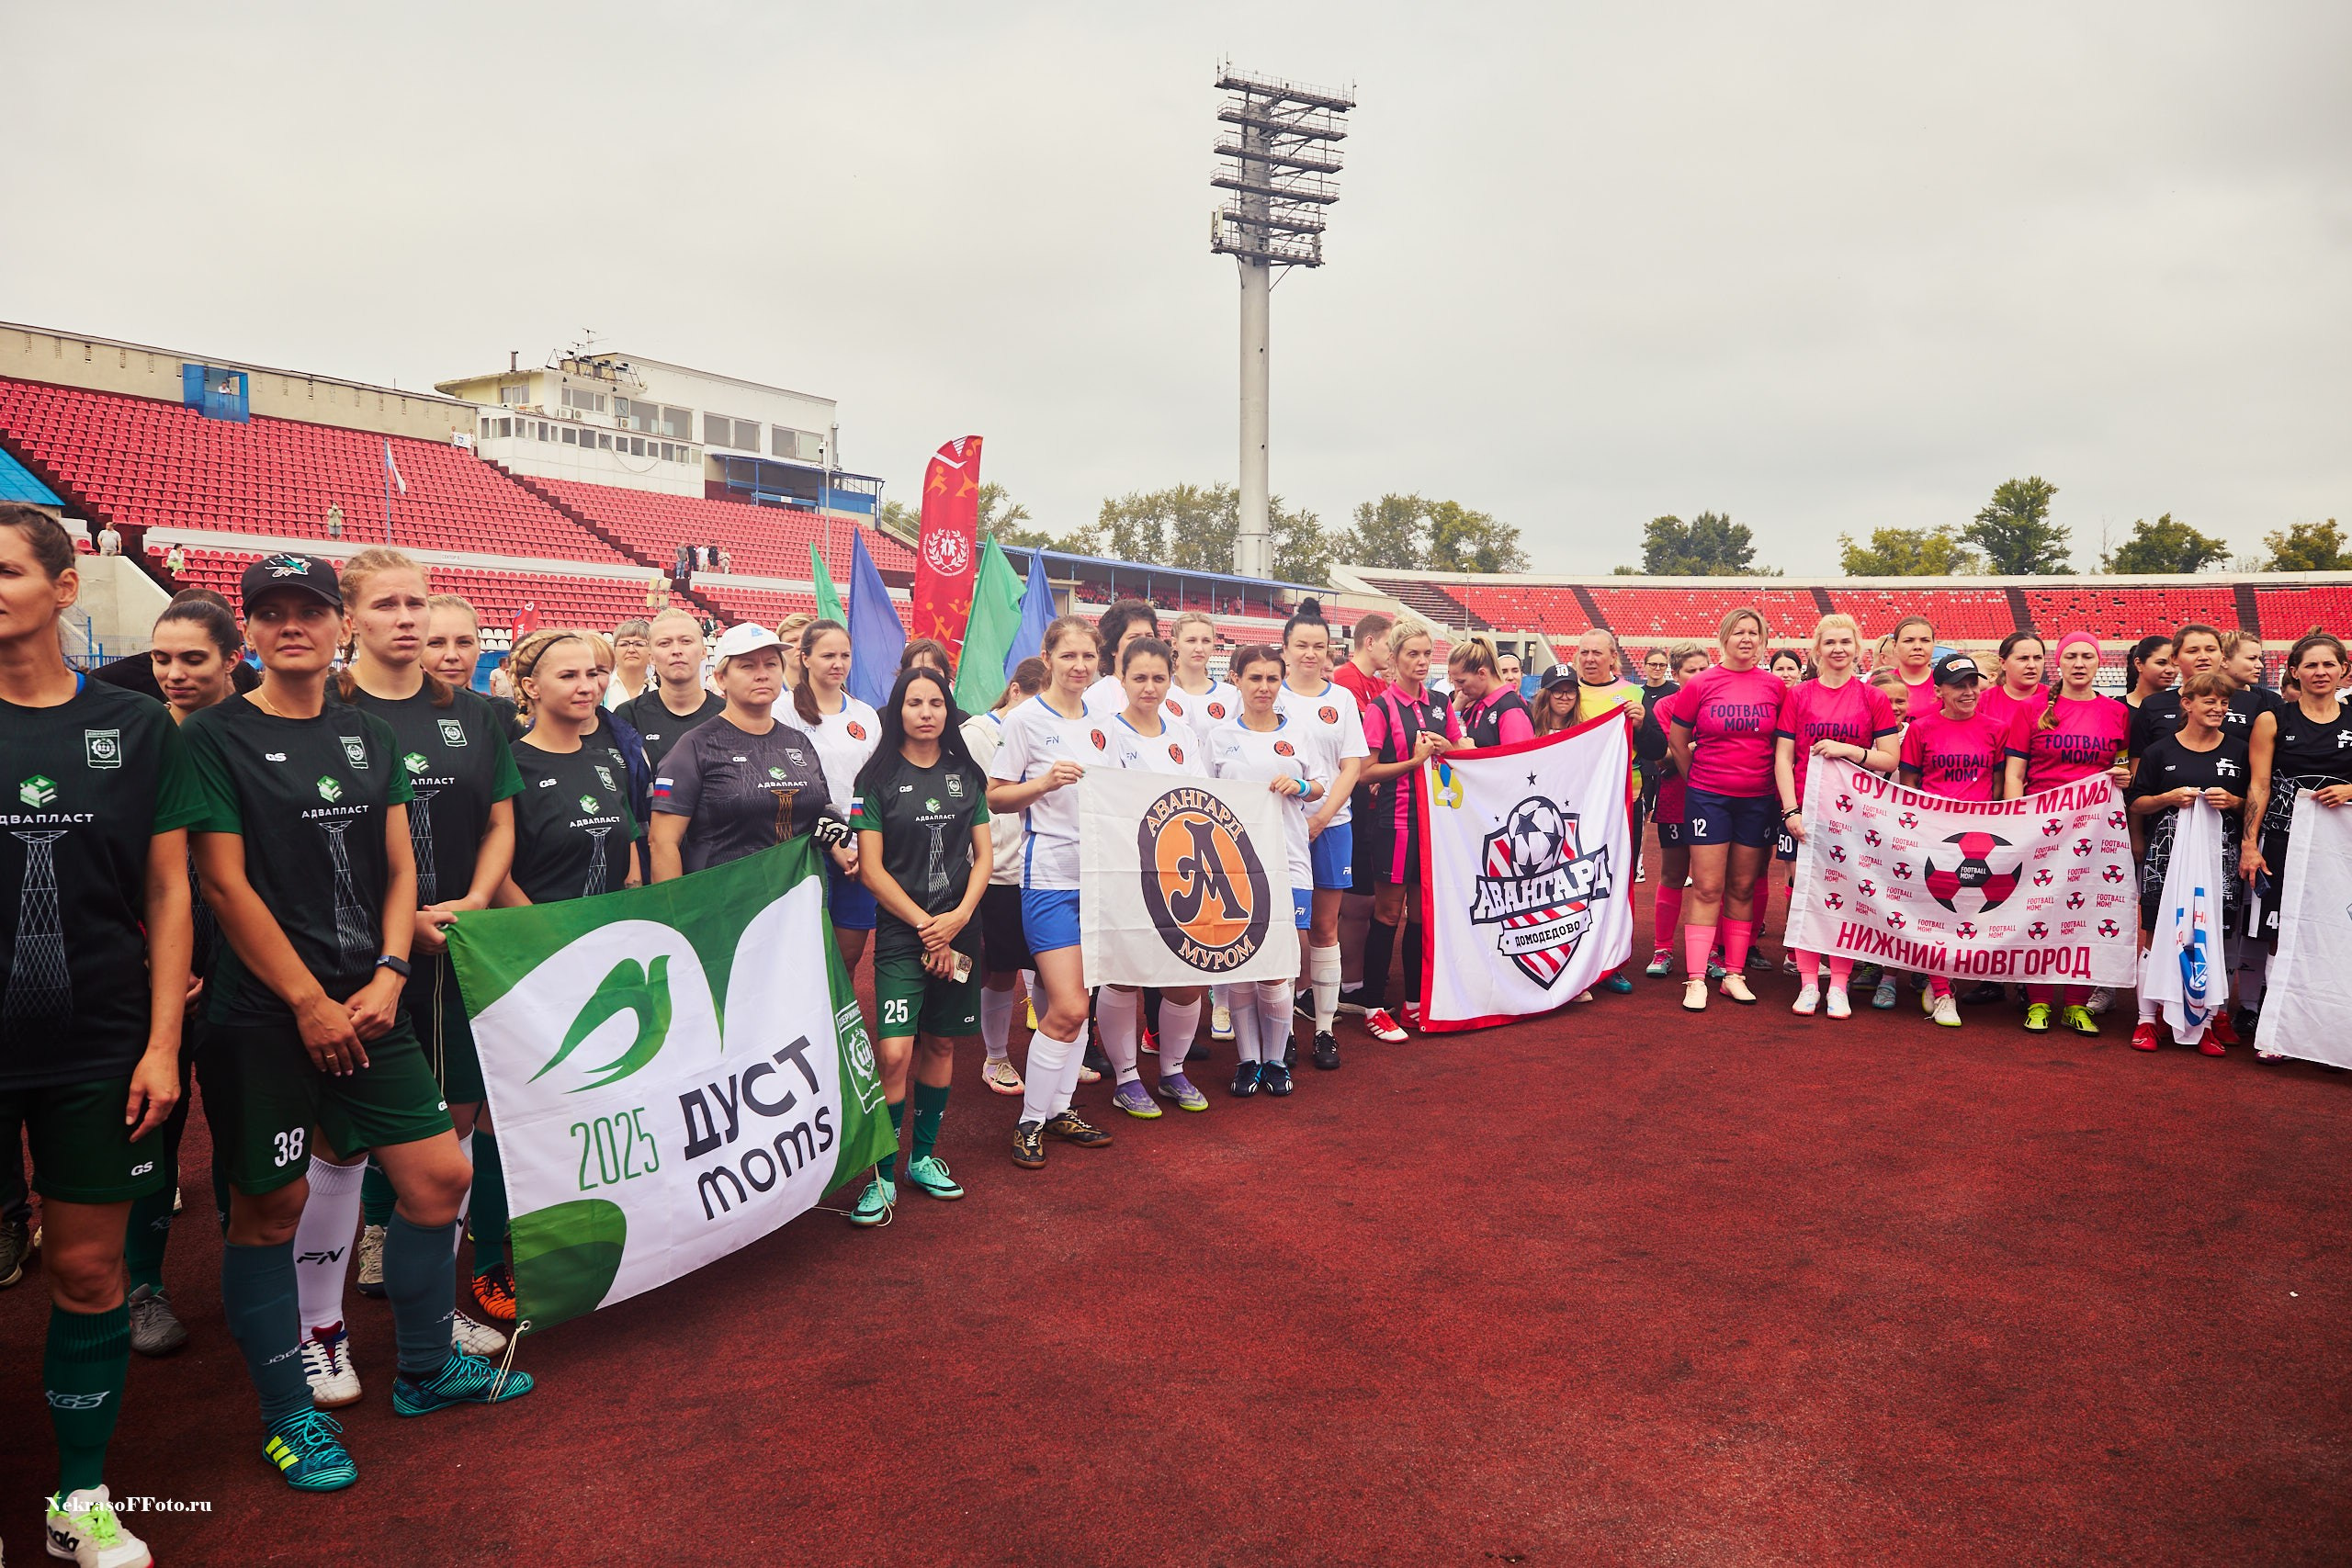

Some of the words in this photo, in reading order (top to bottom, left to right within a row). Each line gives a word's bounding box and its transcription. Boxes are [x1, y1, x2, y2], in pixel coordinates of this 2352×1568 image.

[1711, 705, 1770, 719] FOOTBALL
[1724, 717, 1759, 732] MOM!
[1804, 723, 1860, 739] FOOTBALL
[1046, 736, 1059, 745] FN
[2044, 735, 2114, 752] FOOTBALL
[1932, 754, 1991, 769] FOOTBALL
[2061, 750, 2099, 764] MOM!
[1944, 767, 1978, 782] MOM!
[411, 777, 455, 785] АПЛАСТ
[757, 781, 808, 789] АДВАПЛАСТ
[2035, 779, 2113, 814] МАМЫ
[301, 805, 368, 818] АДВАПЛАСТ
[1146, 789, 1244, 841] АВАНГАРД
[1861, 811, 1877, 819] MOM!
[1862, 804, 1887, 817] FOOTBALL
[0, 814, 94, 826] ДВАПЛАСТ
[570, 816, 620, 828] АДВАПЛАСТ
[2074, 813, 2100, 822] FOOTBALL
[1692, 818, 1707, 837] 12
[1829, 820, 1852, 832] FOOTBALL
[2073, 820, 2087, 829] MOM!
[1828, 827, 1842, 835] MOM!
[1778, 833, 1792, 852] 50
[1891, 843, 1906, 852] MOM!
[1893, 837, 1918, 848] FOOTBALL
[2101, 840, 2131, 850] FOOTBALL
[2035, 844, 2060, 854] FOOTBALL
[1858, 861, 1871, 869] MOM!
[1859, 854, 1883, 866] FOOTBALL
[1825, 869, 1848, 881] FOOTBALL
[1961, 866, 1986, 874] FOOTBALL
[2067, 867, 2090, 875] FOOTBALL
[2067, 874, 2081, 883] MOM!
[1473, 851, 1611, 920] АВАНГАРД
[1885, 893, 1901, 901] MOM!
[1886, 886, 1913, 898] FOOTBALL
[2027, 897, 2054, 905] FOOTBALL
[2096, 899, 2112, 908] MOM!
[2097, 893, 2125, 904] FOOTBALL
[1855, 908, 1869, 916] MOM!
[1856, 901, 1877, 915] FOOTBALL
[1917, 919, 1945, 929] FOOTBALL
[1917, 925, 1932, 933] MOM!
[1989, 924, 2017, 932] FOOTBALL
[2061, 920, 2086, 929] FOOTBALL
[1515, 919, 1580, 948] ДОМОДЕДОВО
[1988, 931, 2004, 939] MOM!
[2061, 927, 2075, 935] MOM!
[1178, 935, 1256, 969] МУРОМ
[1837, 921, 1947, 972] НИЖНИЙ
[1953, 946, 2092, 978] НОВГОРОД
[884, 998, 909, 1024] 25
[678, 1034, 821, 1161] ДУСТ
[274, 1127, 305, 1168] 38
[570, 1107, 660, 1191] 2025
[130, 1161, 154, 1177] GS
[697, 1106, 834, 1221] moms
[262, 1343, 302, 1366] JÖGE
